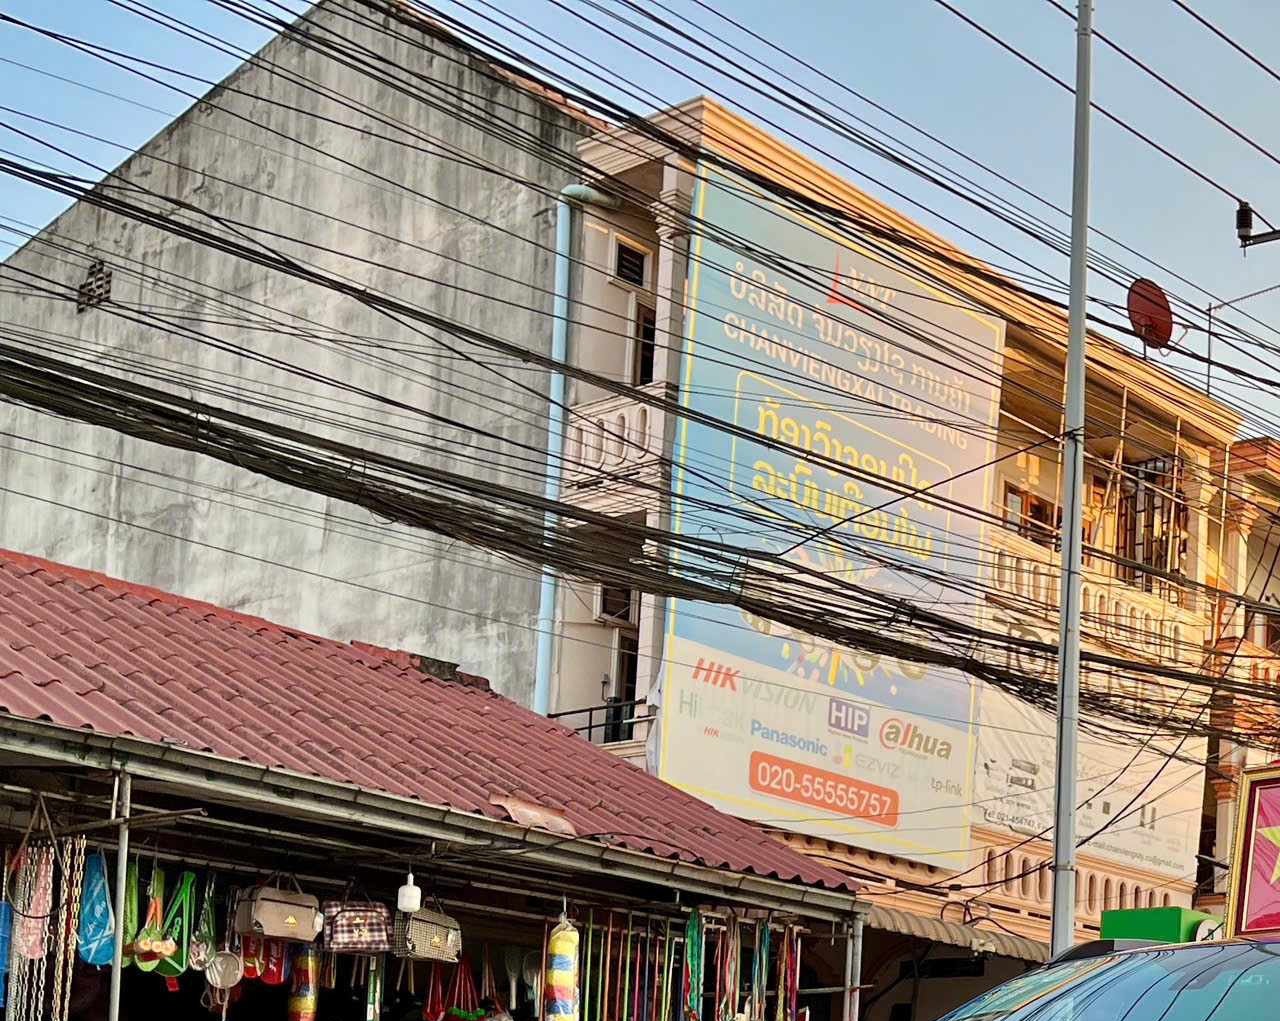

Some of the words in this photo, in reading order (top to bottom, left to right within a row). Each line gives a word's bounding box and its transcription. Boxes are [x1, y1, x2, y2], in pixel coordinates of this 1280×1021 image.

[889, 391, 969, 450] TRADING
[830, 701, 869, 733] HIP
[750, 719, 828, 757] Panasonic
[757, 761, 892, 818] 020-55555757
[931, 776, 964, 798] tp-link
